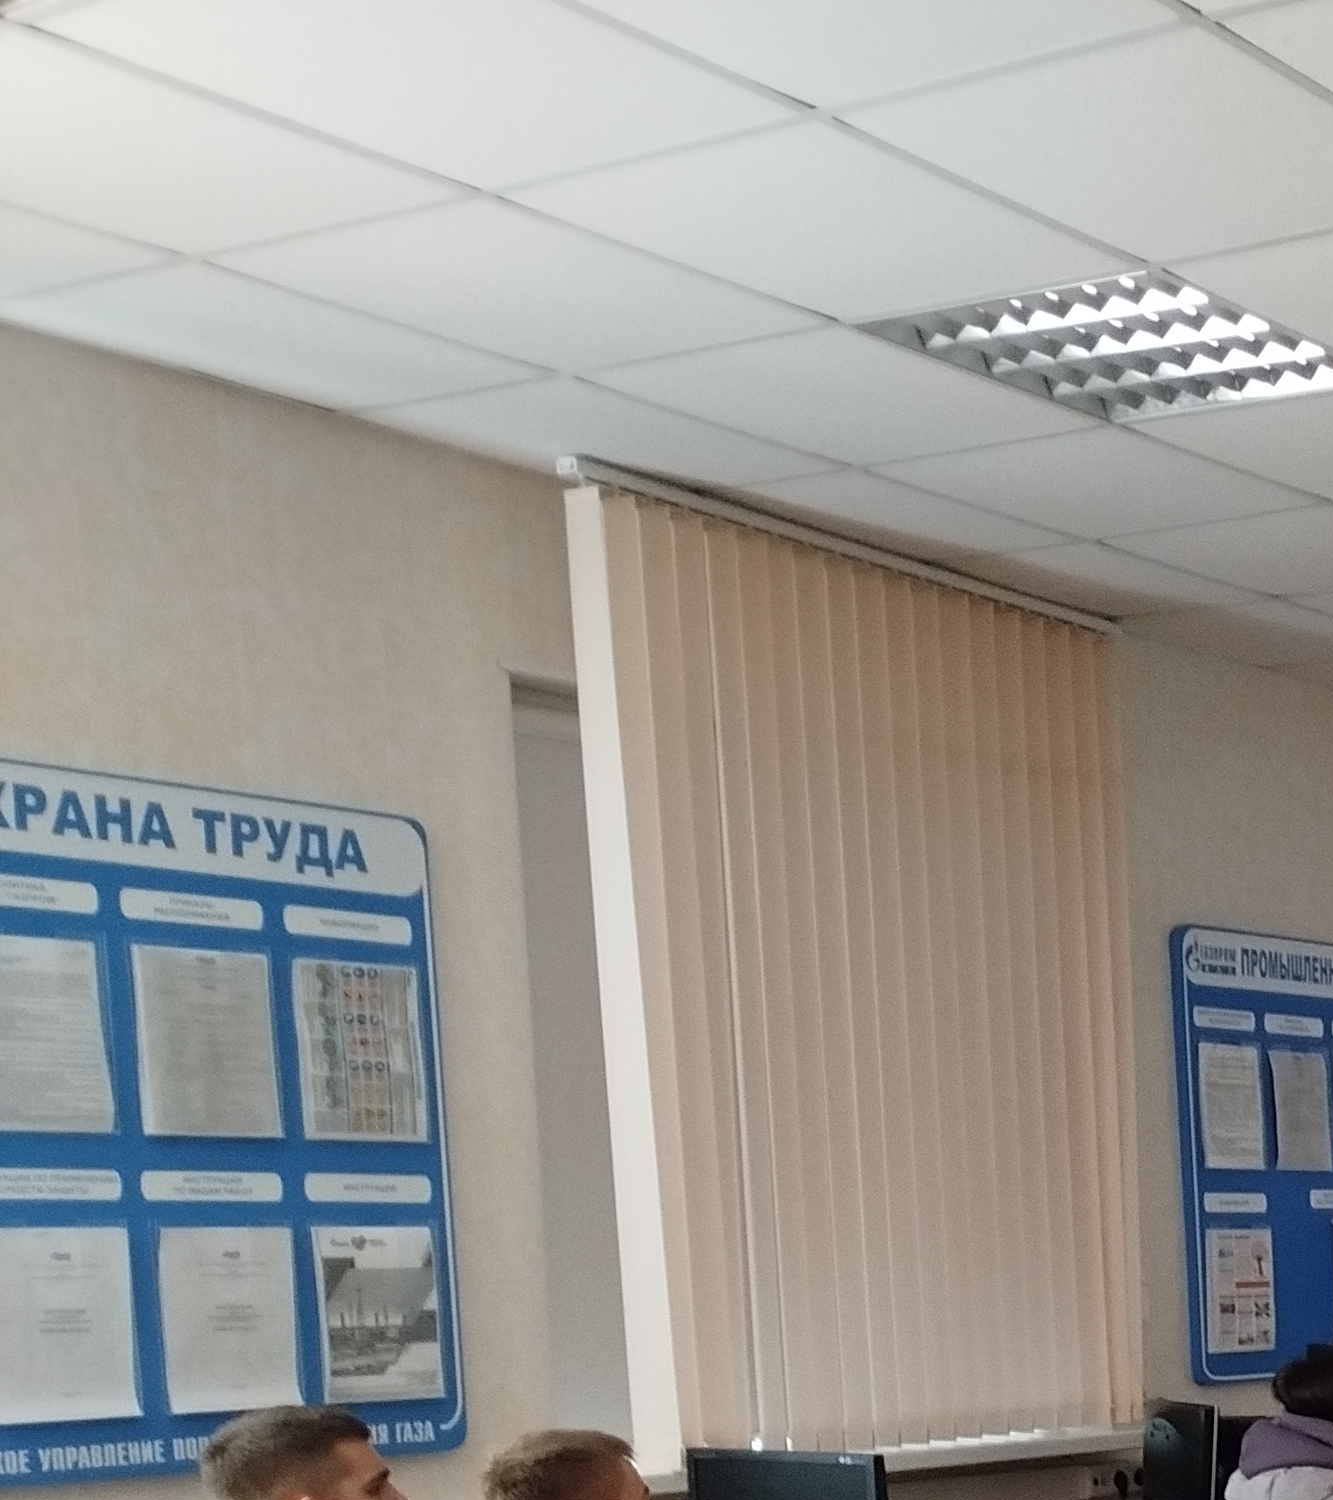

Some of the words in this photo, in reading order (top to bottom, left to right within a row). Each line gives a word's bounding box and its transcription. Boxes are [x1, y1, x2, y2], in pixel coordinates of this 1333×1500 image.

[192, 806, 369, 878] ТРУДА
[395, 1420, 436, 1443] ГАЗА
[38, 1438, 167, 1473] УПРАВЛЕНИЕ
